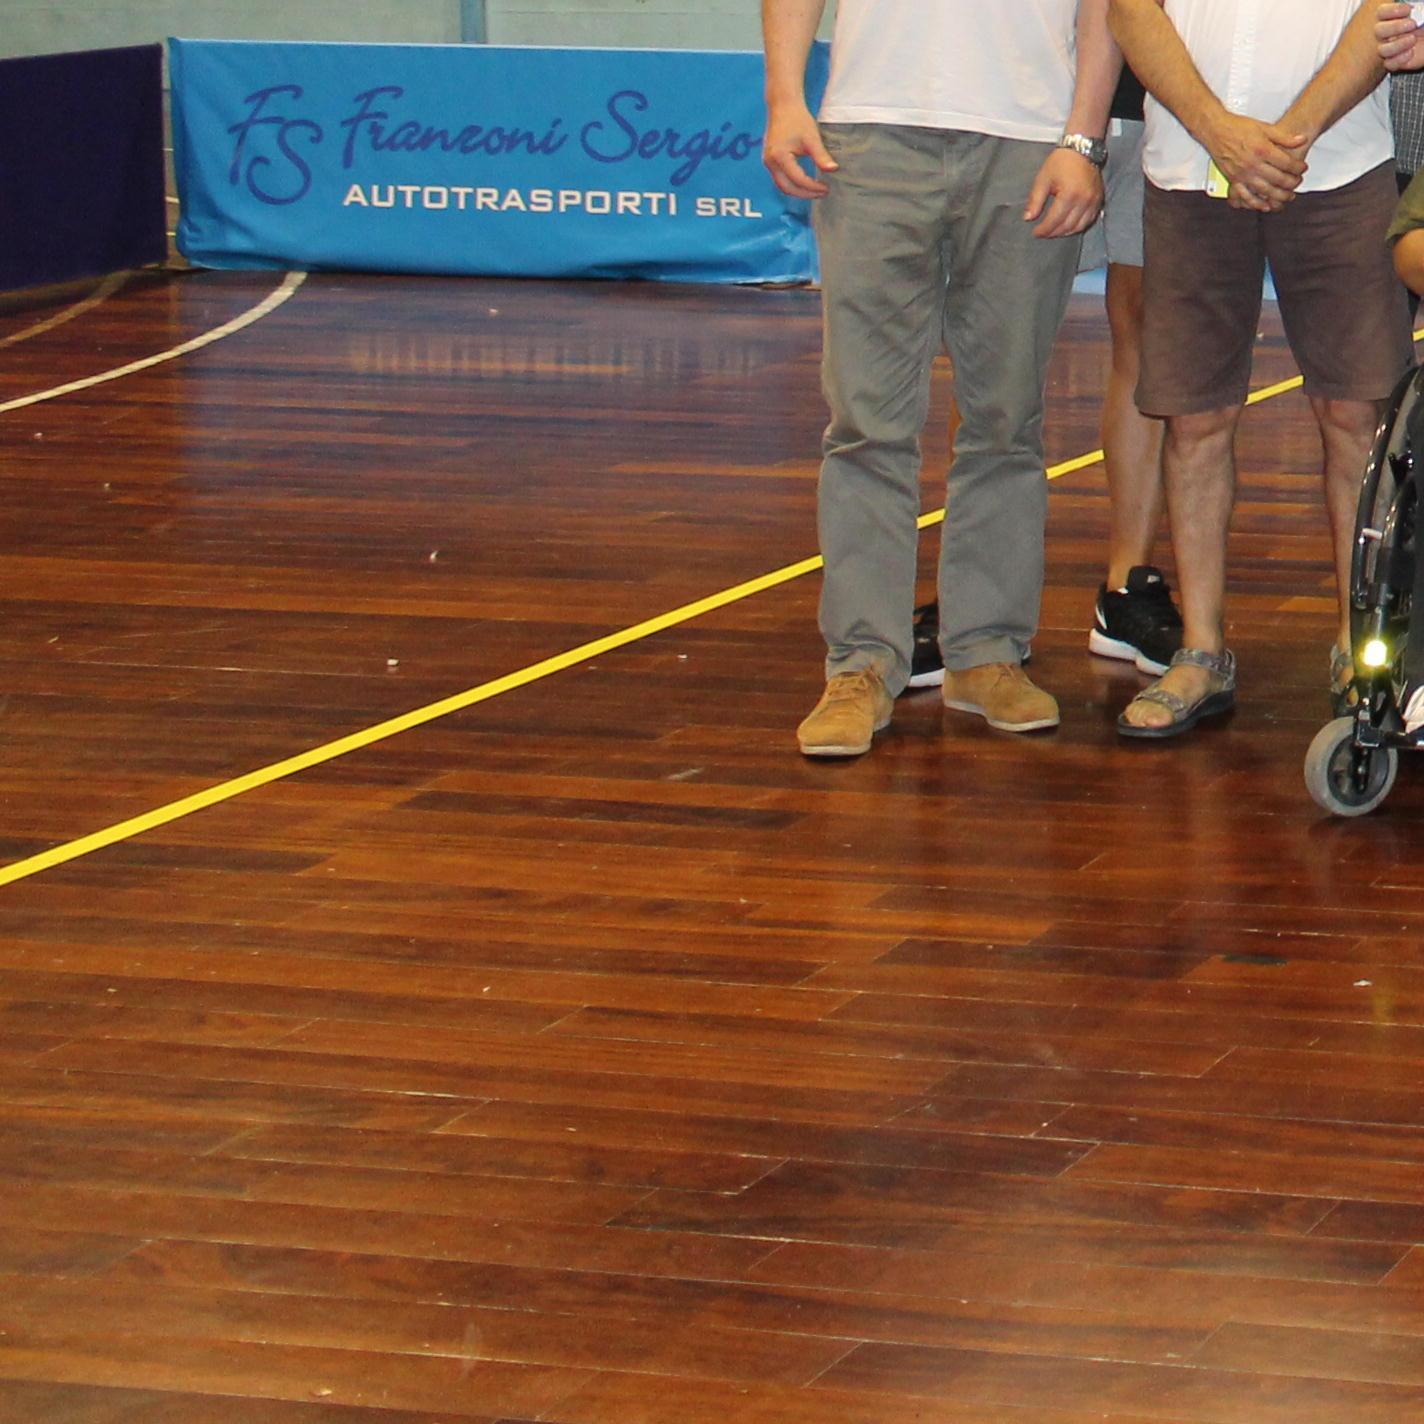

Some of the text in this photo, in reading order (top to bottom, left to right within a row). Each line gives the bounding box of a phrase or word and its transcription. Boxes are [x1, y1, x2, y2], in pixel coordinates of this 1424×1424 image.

[341, 85, 765, 187] Franzoni Sergio
[342, 184, 763, 219] AUTOTRASPORTI SRL
